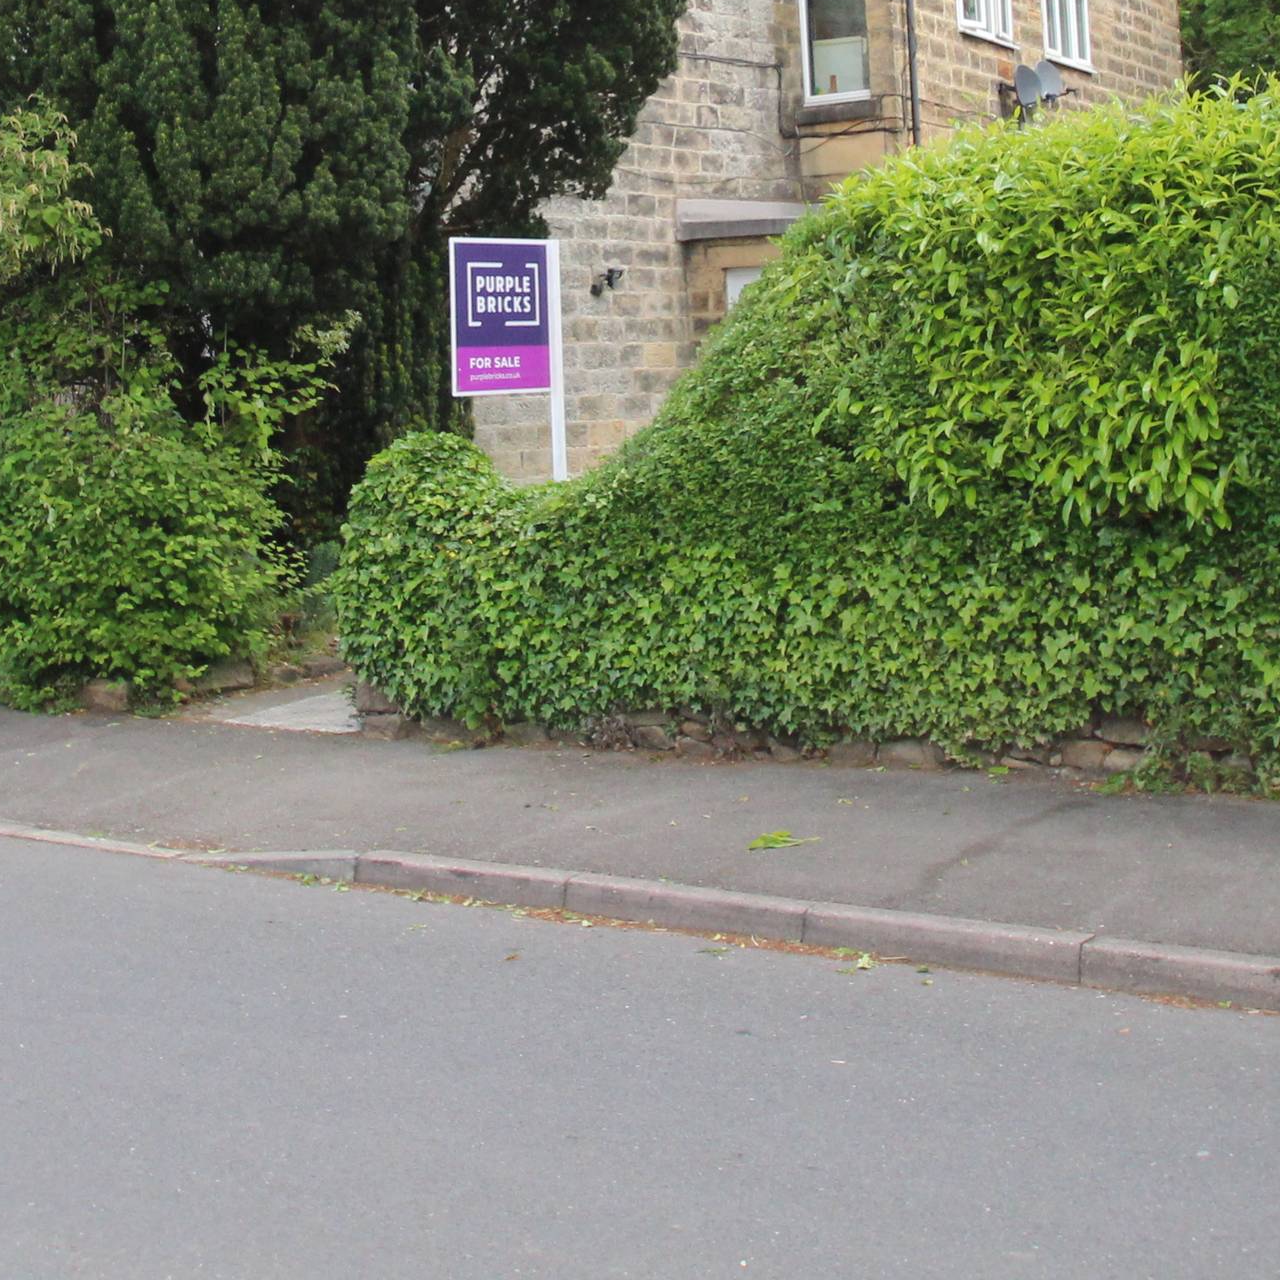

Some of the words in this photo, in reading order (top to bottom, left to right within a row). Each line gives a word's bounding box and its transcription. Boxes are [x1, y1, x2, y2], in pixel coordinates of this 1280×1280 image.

[476, 276, 531, 293] PURPLE
[476, 296, 531, 313] BRICKS
[470, 357, 491, 369] FOR
[494, 356, 521, 368] SALE
